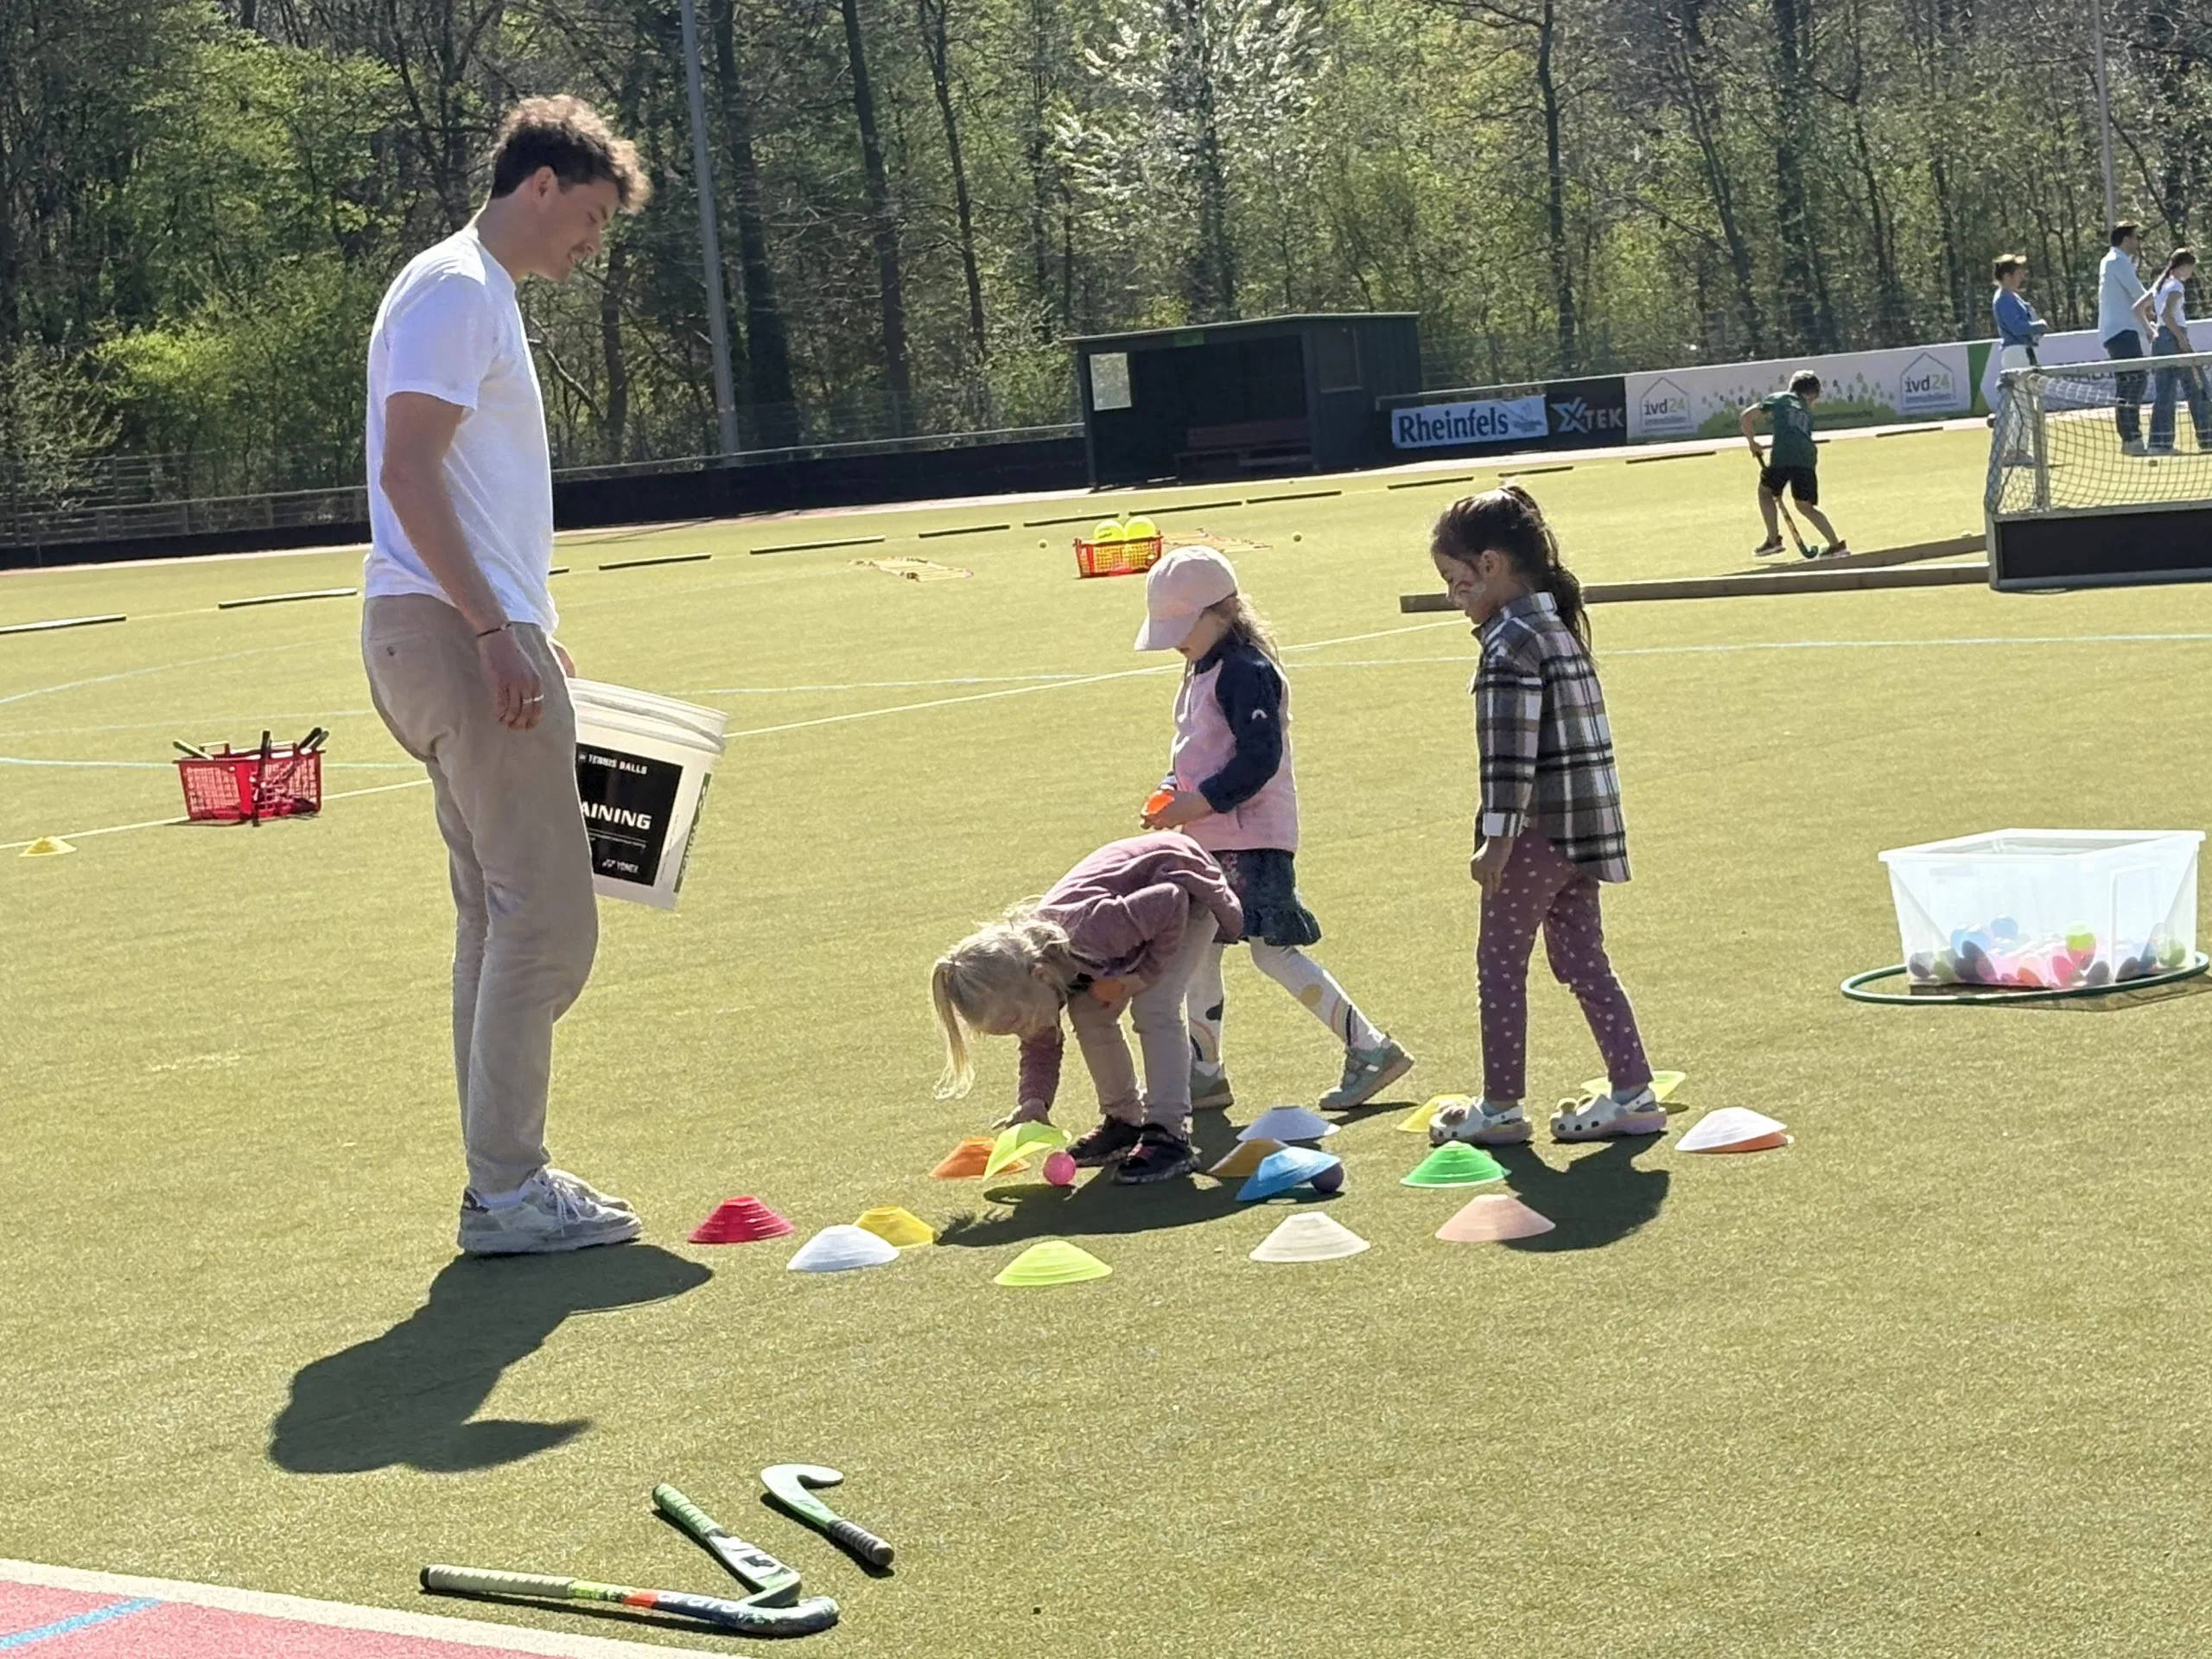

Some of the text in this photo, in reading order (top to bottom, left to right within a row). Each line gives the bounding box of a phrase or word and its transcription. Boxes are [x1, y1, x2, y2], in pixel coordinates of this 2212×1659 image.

[1904, 373, 1950, 393] ivd24
[1643, 397, 1687, 416] ivd24
[1397, 406, 1510, 443] Rheinfels
[588, 753, 617, 768] TENNIS
[619, 760, 648, 775] BALLS
[617, 861, 640, 874] YONEX
